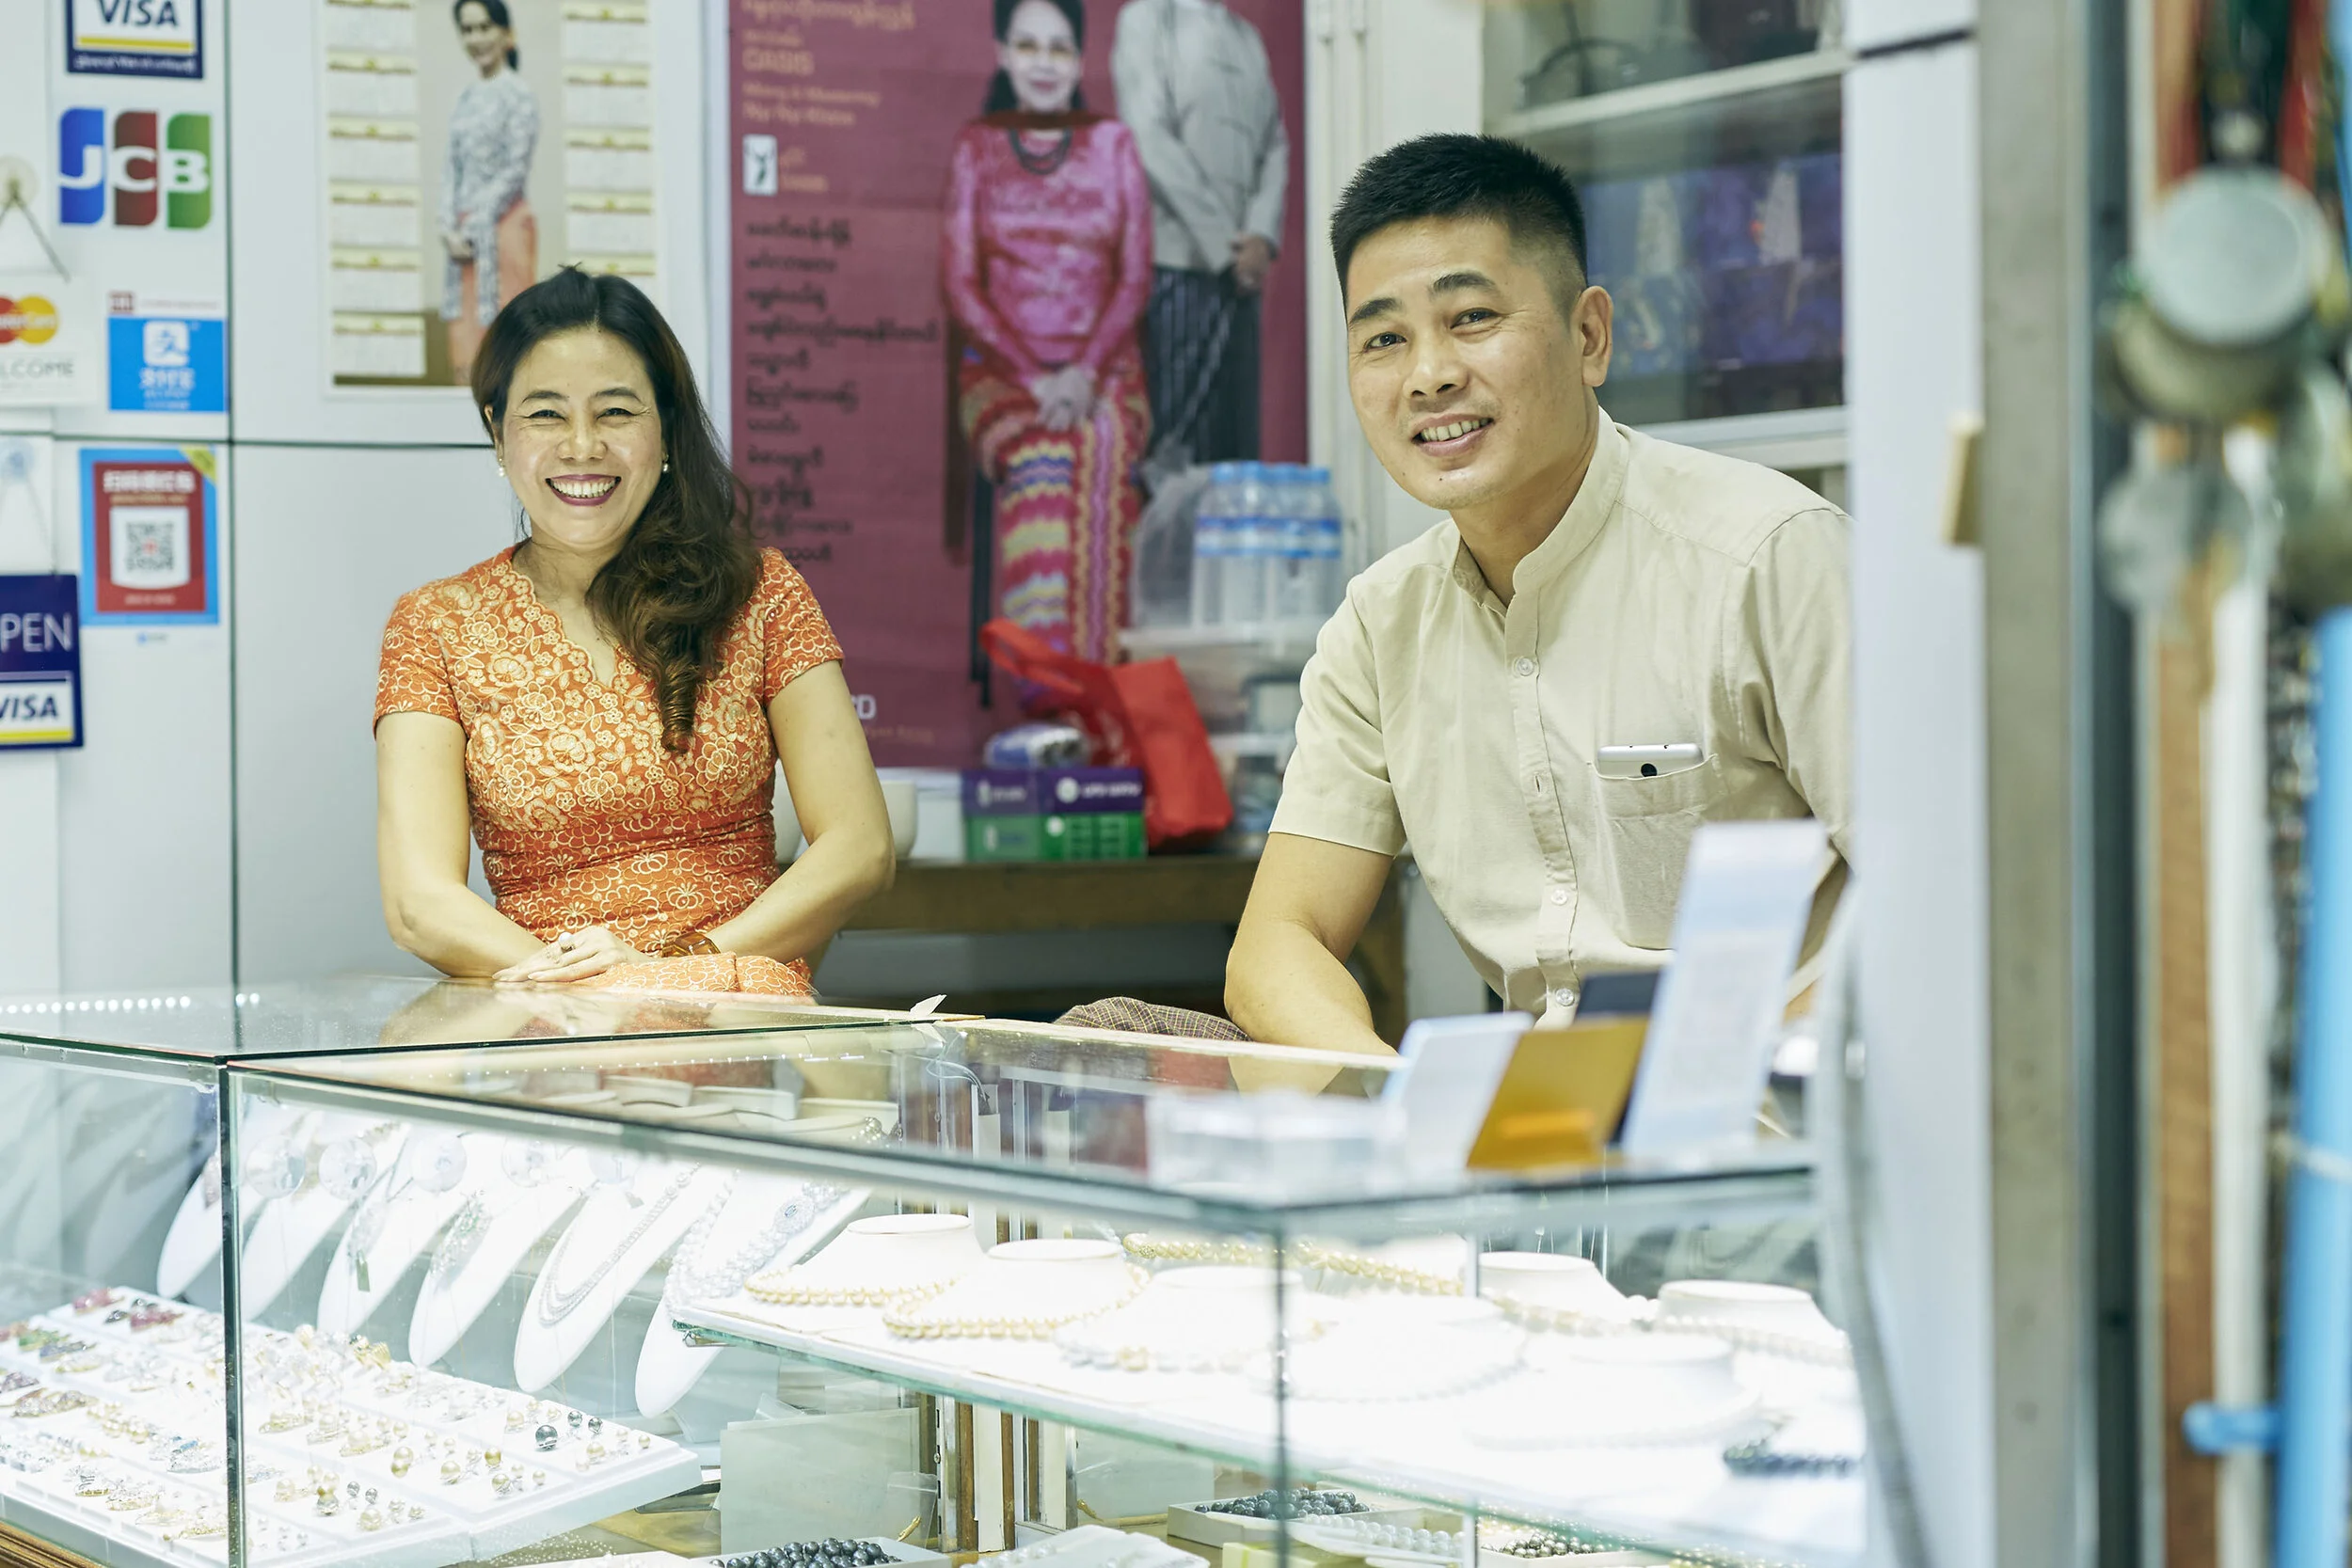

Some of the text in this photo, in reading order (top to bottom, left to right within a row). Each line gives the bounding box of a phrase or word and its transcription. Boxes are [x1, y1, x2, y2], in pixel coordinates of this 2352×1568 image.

[98, 0, 178, 26] VISA
[0, 358, 74, 379] LCOME
[0, 612, 72, 653] PEN
